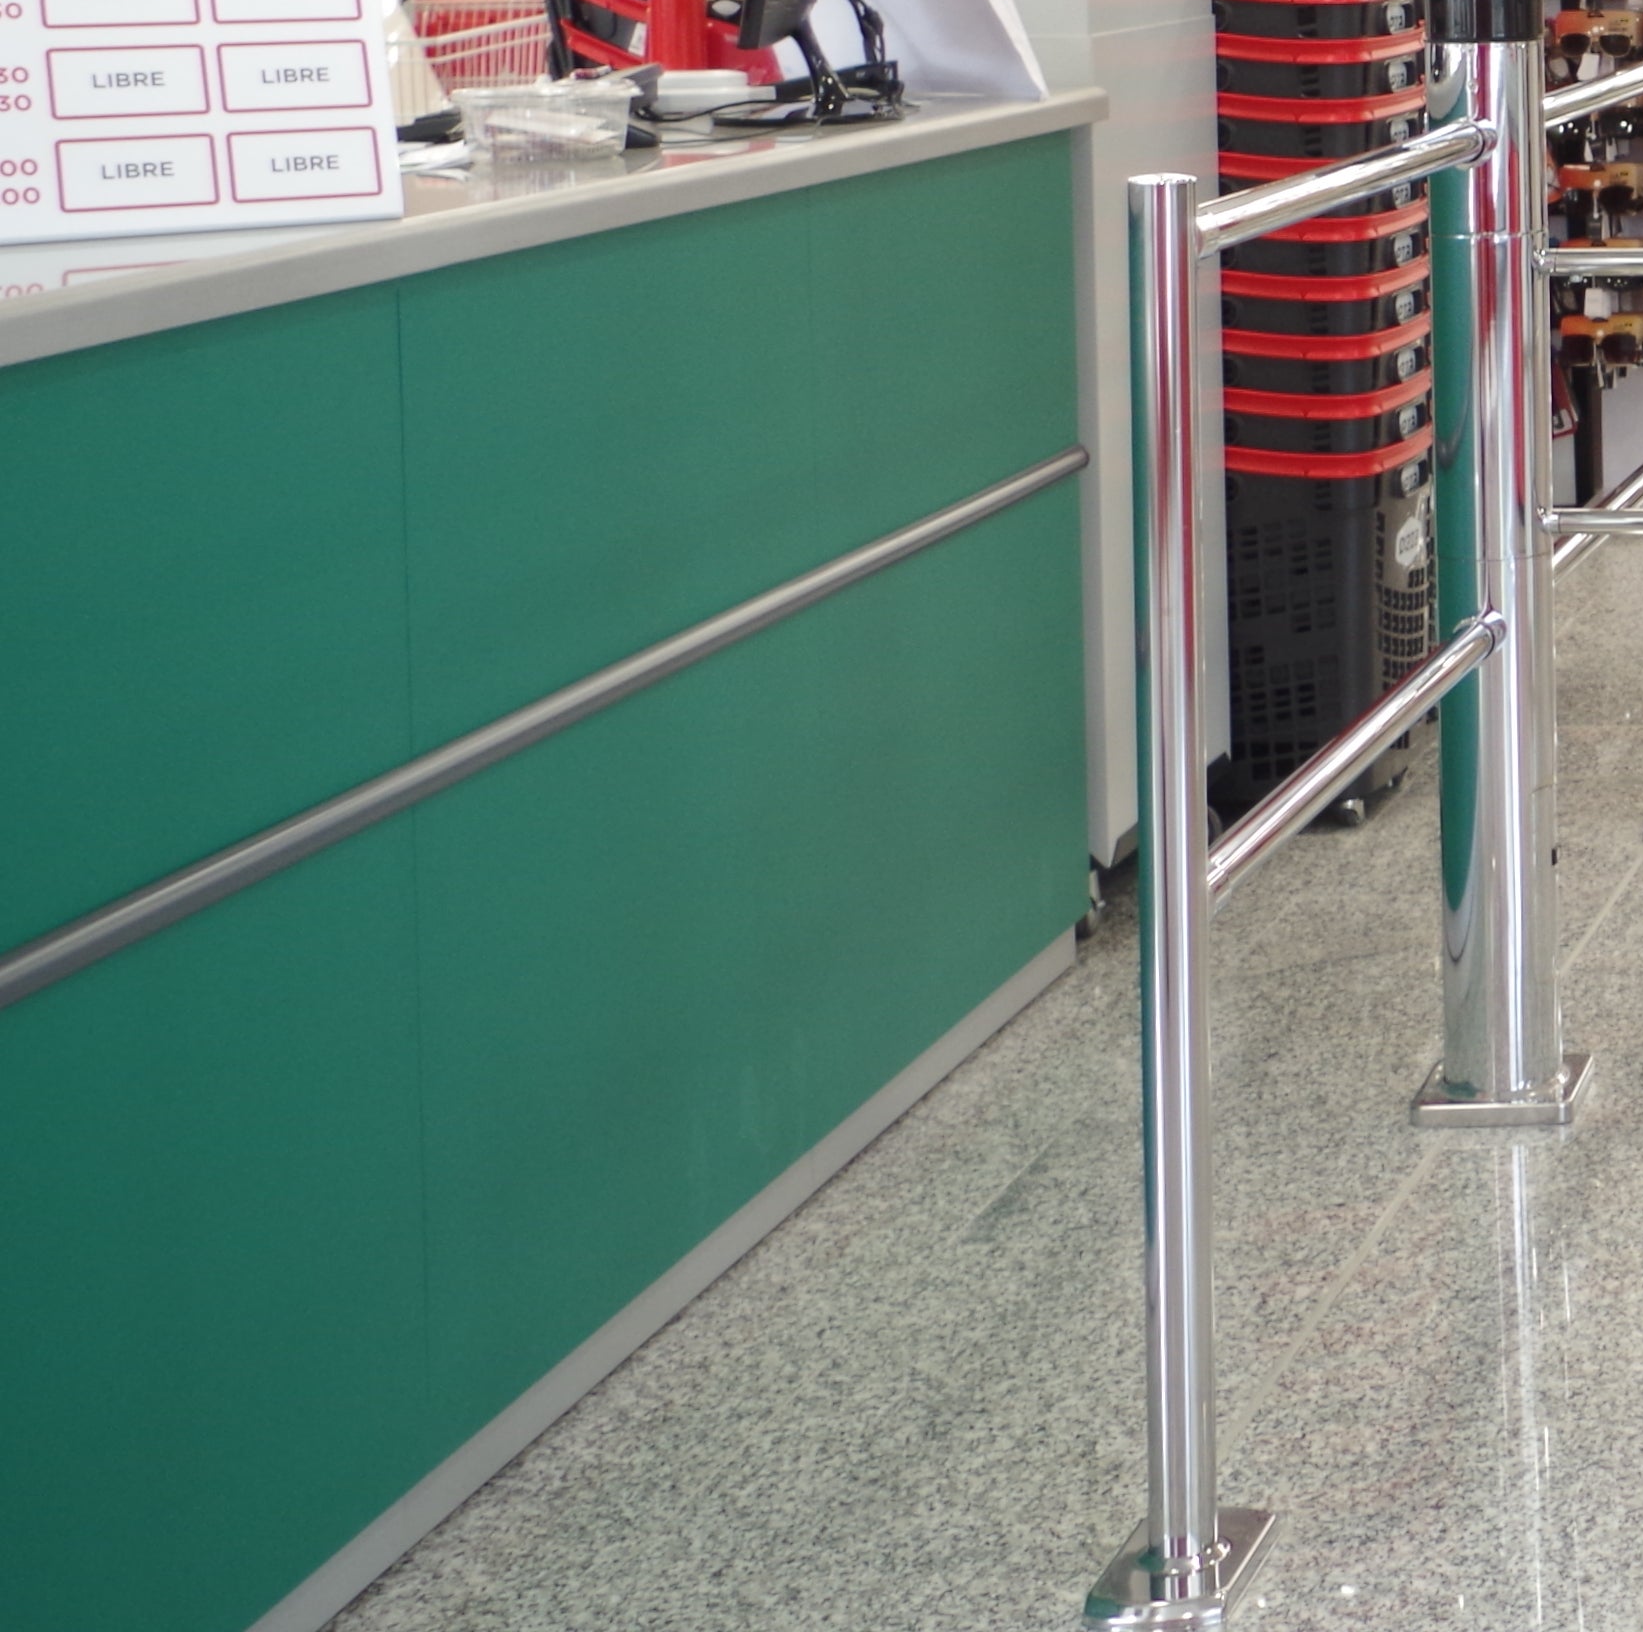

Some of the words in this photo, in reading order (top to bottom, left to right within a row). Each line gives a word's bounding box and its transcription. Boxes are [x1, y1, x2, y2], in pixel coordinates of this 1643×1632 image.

[92, 71, 166, 89] LIBRE
[261, 67, 331, 84] LIBRE
[101, 161, 175, 180] LIBRE
[271, 154, 341, 173] LIBRE
